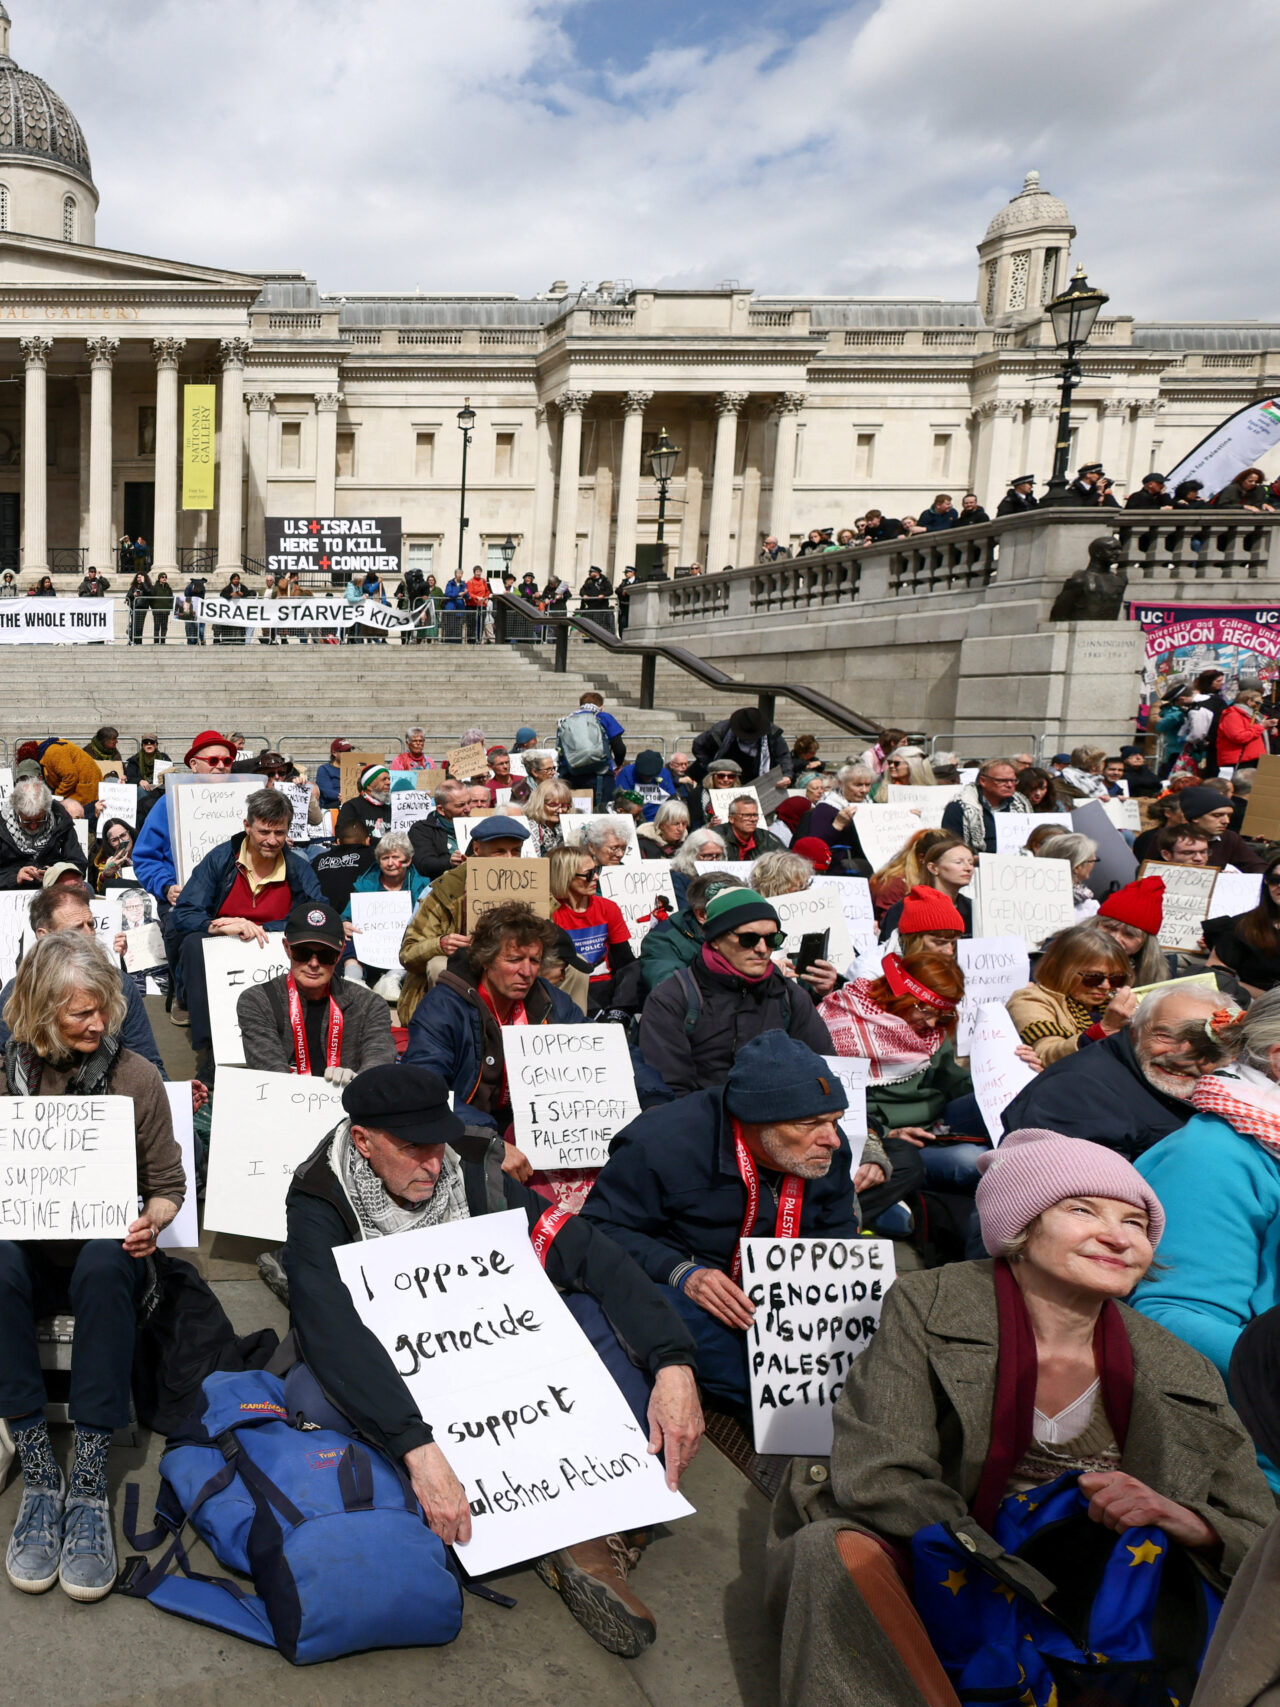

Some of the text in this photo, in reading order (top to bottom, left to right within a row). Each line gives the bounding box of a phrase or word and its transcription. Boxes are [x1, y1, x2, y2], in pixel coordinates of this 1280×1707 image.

[45, 307, 140, 319] GALLERY
[192, 405, 200, 463] NATIONAL
[200, 406, 210, 464] GALLERY
[280, 538, 387, 552] HERE TO KILL
[0, 613, 21, 628] THE
[24, 612, 66, 628] WHOLE
[69, 612, 107, 627] TRUTH
[200, 602, 270, 621] ISRAEL
[277, 605, 365, 622] STARVES
[1146, 628, 1280, 657] LONDON REGION
[397, 803, 430, 811] GENOCIDE
[472, 869, 538, 891] I OPPOSE
[603, 871, 670, 898] I OPPOSE
[1000, 864, 1068, 893] OPPOSE
[1162, 868, 1214, 888] OPPOSE
[778, 897, 834, 922] OPPOSE
[988, 899, 1070, 923] GENOCIDE
[967, 952, 1016, 970] I OPPOSE
[227, 969, 245, 986] I
[904, 978, 921, 995] FREE
[296, 1025, 306, 1071] PALESTINIAN
[520, 1033, 605, 1057] I OPPOSE
[521, 1065, 607, 1087] GENICIDE
[257, 1083, 270, 1101] I
[11, 1101, 108, 1128] I OPPOSE
[530, 1100, 628, 1124] I SUPPORT
[531, 1127, 612, 1148] PALESTINE
[5, 1165, 86, 1195] SUPPORT
[247, 1160, 265, 1176] I
[736, 1143, 757, 1200] HOSTAGES
[747, 1242, 885, 1273] I OPPOSE
[361, 1249, 515, 1302] I oppose
[394, 1303, 544, 1377] genocide
[755, 1315, 880, 1346] I SUPPOR
[753, 1350, 855, 1379] PALESTI
[447, 1384, 575, 1446] support
[463, 1470, 560, 1518] alestine
